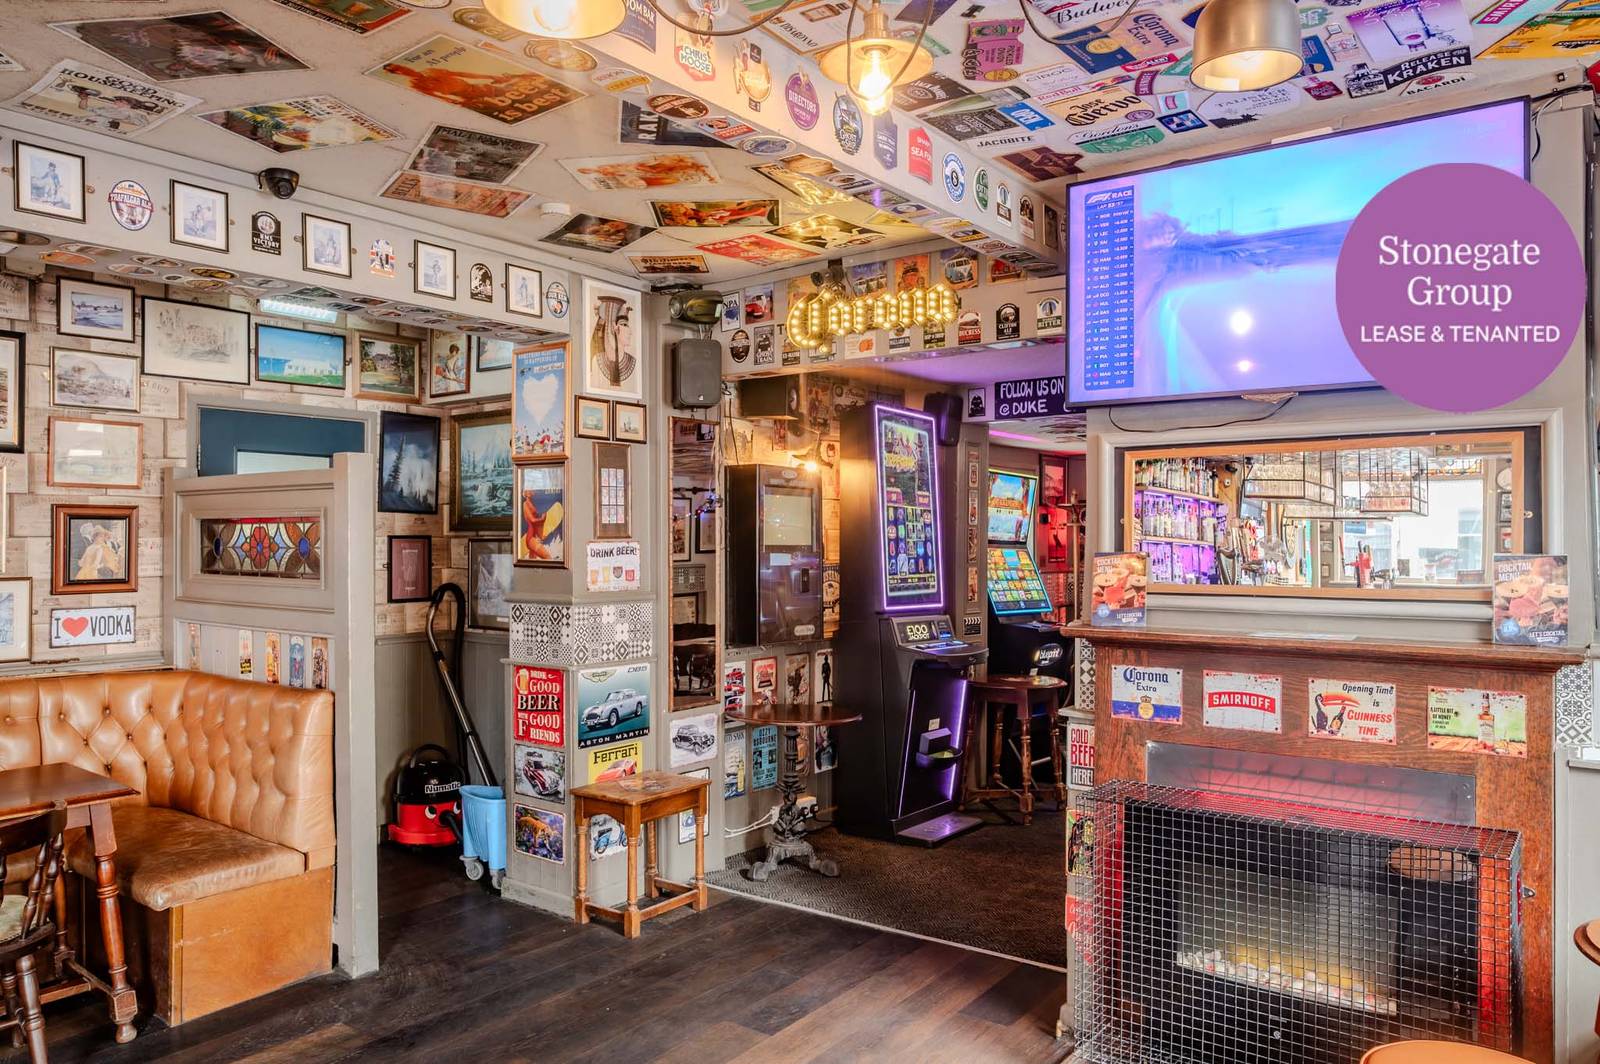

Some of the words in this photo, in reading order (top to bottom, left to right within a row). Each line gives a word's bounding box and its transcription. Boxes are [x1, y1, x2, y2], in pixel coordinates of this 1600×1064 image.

[643, 5, 656, 24] BAR
[1127, 24, 1150, 45] Extra
[1132, 14, 1179, 46] Corona
[404, 53, 420, 64] For
[681, 53, 711, 73] MOOSE
[1401, 52, 1452, 71] RELEASE
[1387, 56, 1466, 85] KRAKEN
[60, 68, 186, 108] HOUSEKEEPING
[105, 74, 158, 95] GOOD
[490, 76, 549, 107] beer
[1407, 77, 1466, 95] BACARDI
[499, 106, 522, 121] is
[520, 86, 571, 113] best
[788, 89, 817, 114] DIRECTORS
[1069, 98, 1106, 112] Jose
[1065, 95, 1142, 127] Cuervo
[1111, 190, 1132, 199] RACE
[253, 238, 281, 249] VICTORY
[787, 284, 959, 349] Corona
[1000, 381, 1033, 399] FOLLOW
[1037, 379, 1049, 397] US
[1050, 378, 1065, 395] ON
[1013, 399, 1048, 415] DUKE
[590, 548, 615, 559] DRINK
[617, 547, 638, 557] BEER!
[1498, 562, 1532, 574] COCKTAIL
[54, 617, 61, 639] I
[90, 614, 132, 637] VODKA
[907, 625, 928, 635] £100
[908, 633, 930, 641] JACKPOT
[1123, 667, 1169, 684] Corona
[530, 680, 560, 694] GOOD
[1136, 683, 1157, 692] Extra
[1342, 683, 1373, 696] Opening
[1375, 686, 1394, 696] Time
[517, 694, 559, 711] BEER
[1372, 699, 1380, 708] is
[530, 713, 560, 730] GOOD
[1347, 709, 1393, 723] GUINNESS
[518, 718, 560, 744] FRIENDS
[580, 736, 610, 748] ASTON
[615, 728, 650, 741] MARTIN
[759, 727, 771, 737] OZZY
[1071, 728, 1088, 745] COLD
[1358, 726, 1378, 737] TIME
[593, 743, 638, 765] Ferrari
[1071, 744, 1096, 768] BEER
[1072, 769, 1094, 786] HERE!
[424, 781, 461, 794] Numatic
